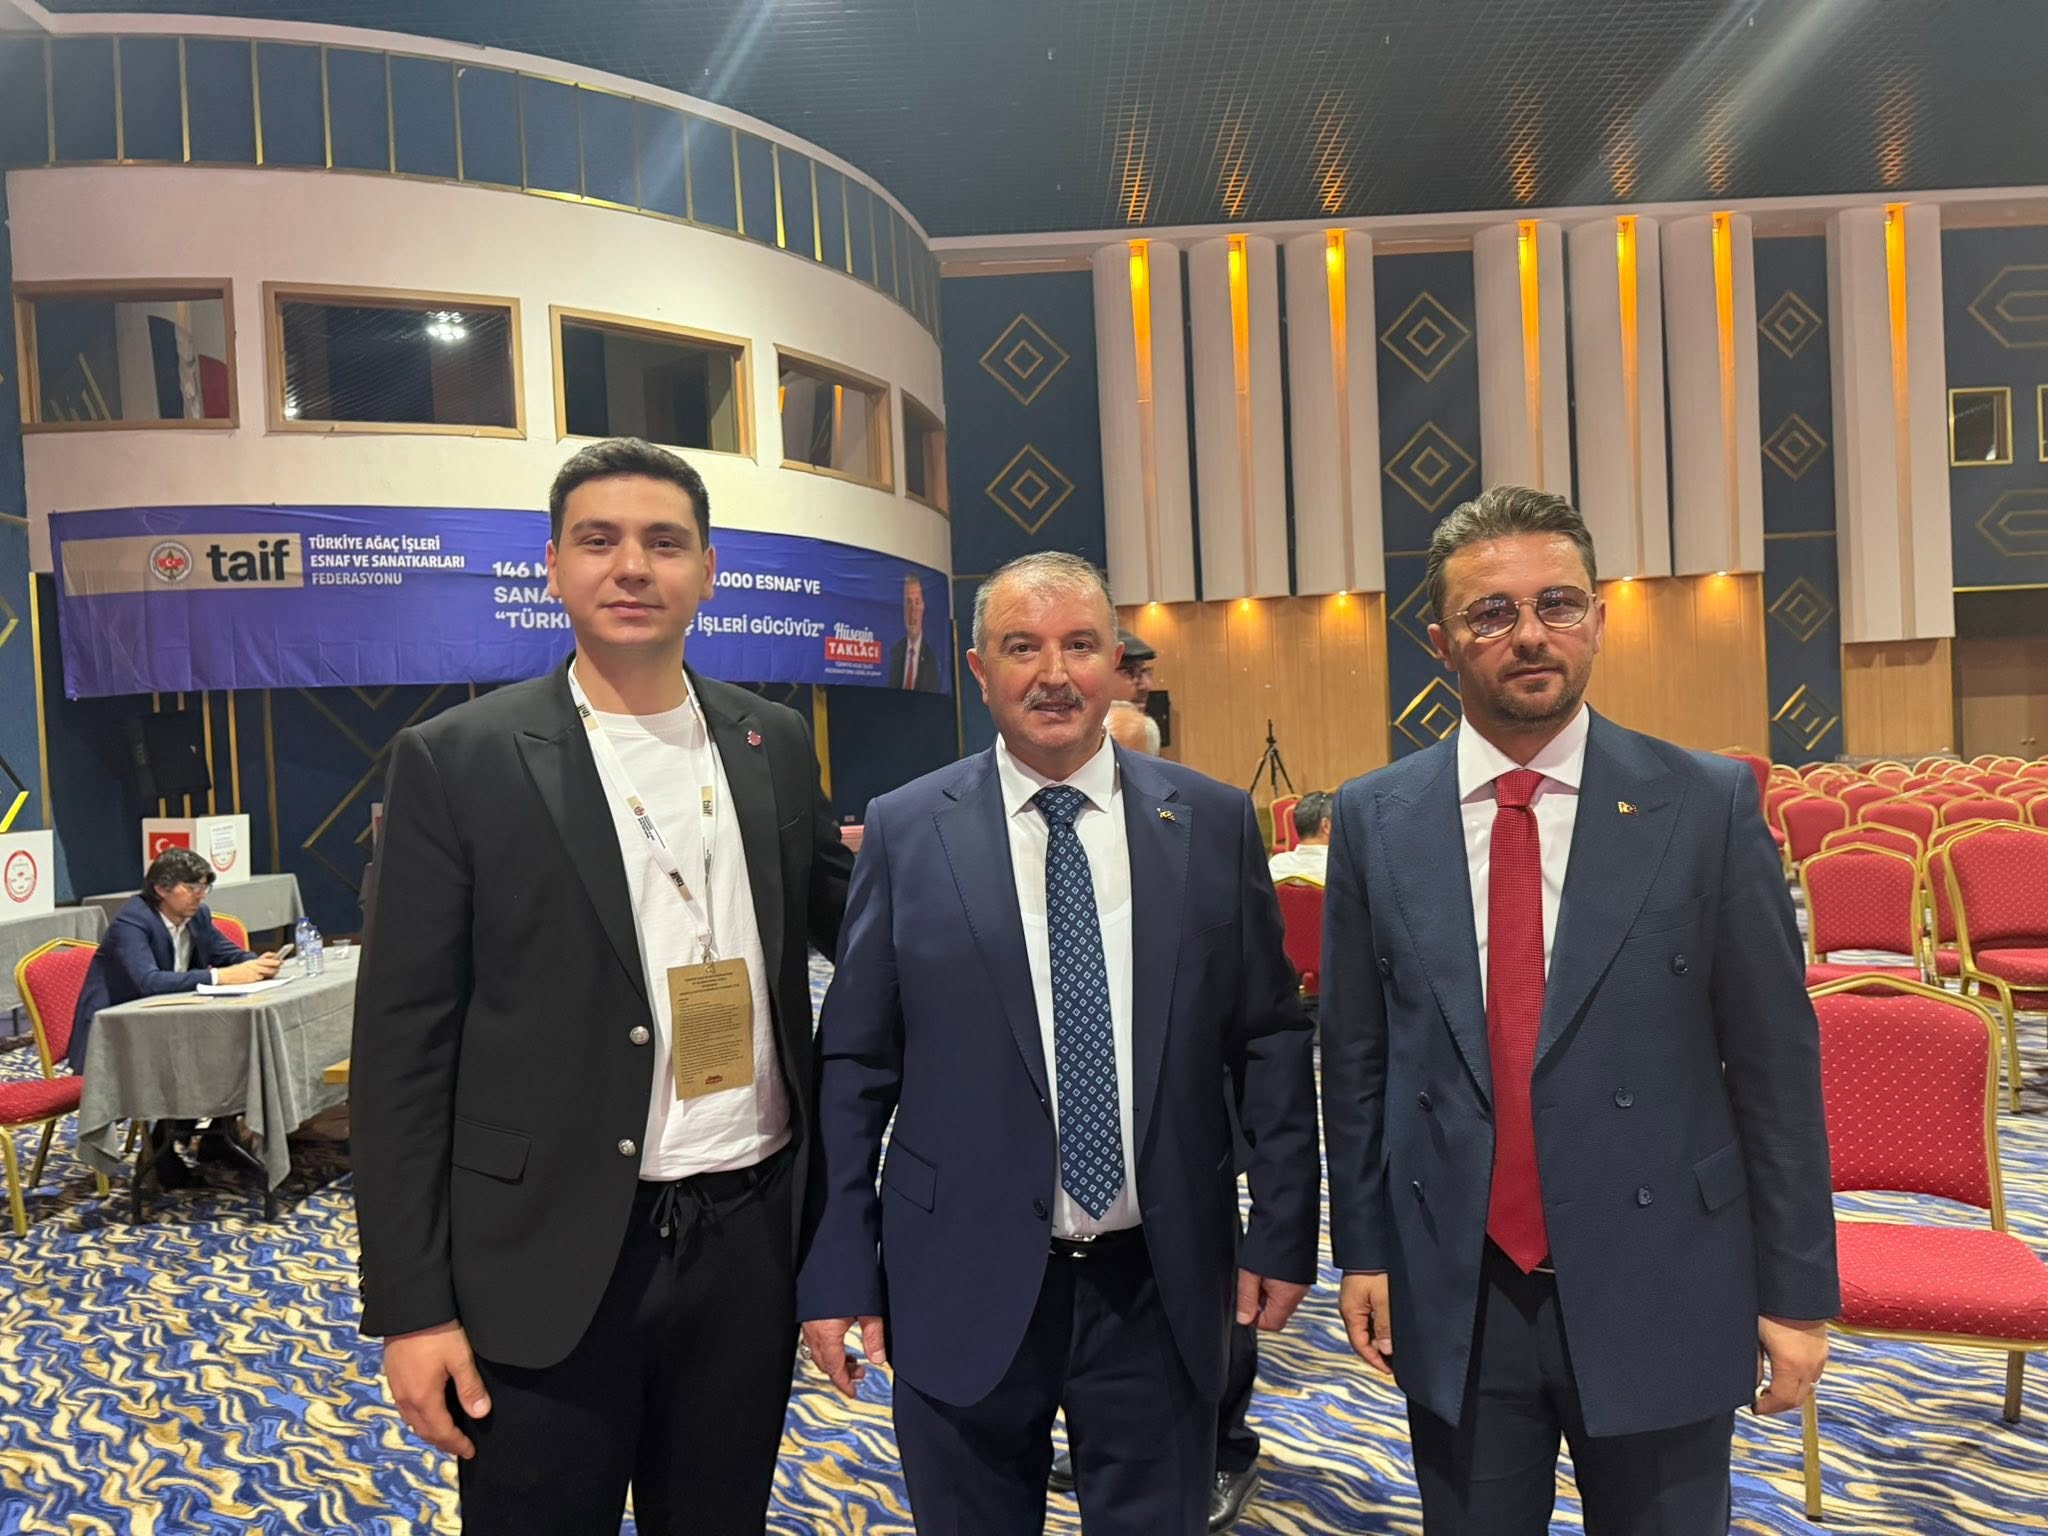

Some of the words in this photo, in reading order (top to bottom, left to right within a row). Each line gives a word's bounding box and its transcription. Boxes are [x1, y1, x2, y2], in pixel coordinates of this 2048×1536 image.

[309, 534, 363, 550] TÜRKİYE
[365, 535, 400, 554] AĞAÇ
[402, 534, 440, 554] İŞLERİ
[206, 539, 290, 583] taif
[310, 555, 351, 568] ESNAF
[353, 555, 370, 567] VE
[371, 555, 465, 568] SANATKARLARI
[312, 572, 403, 585] FEDERASYONU
[492, 561, 530, 578] 146
[712, 571, 753, 589] .000
[755, 574, 802, 592] ESNAF
[803, 580, 821, 594] VE
[494, 586, 562, 604] SANA
[697, 612, 748, 637] İŞLERİ
